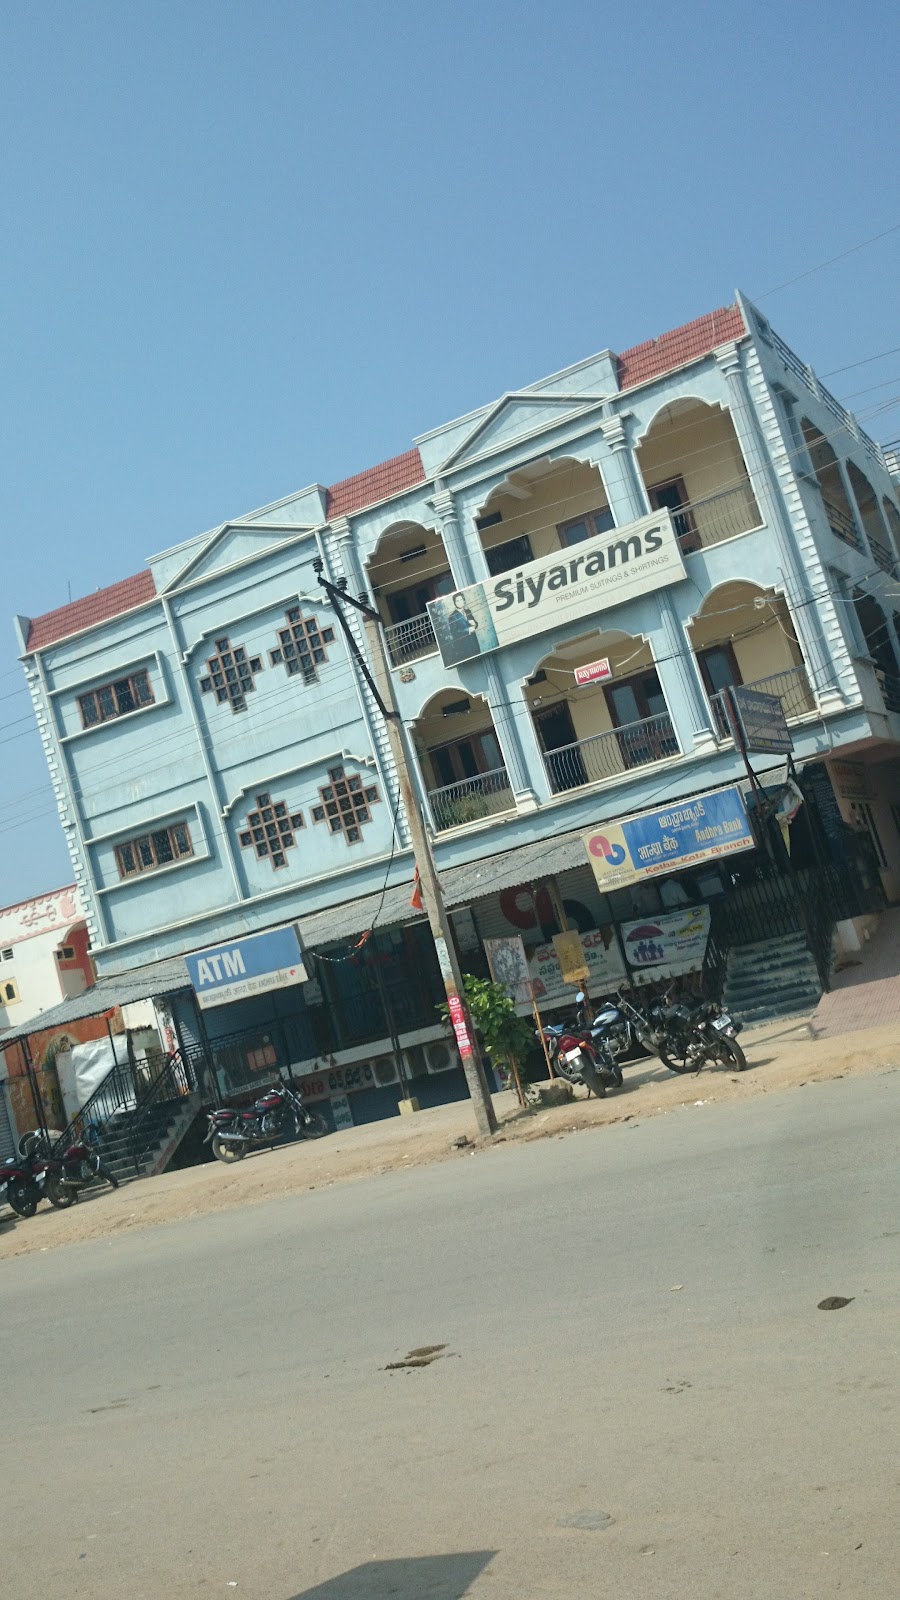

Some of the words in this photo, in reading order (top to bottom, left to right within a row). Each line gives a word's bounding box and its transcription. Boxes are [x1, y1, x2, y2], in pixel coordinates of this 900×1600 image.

[494, 526, 663, 612] Siyarams
[556, 586, 589, 603] PREMIUM
[590, 573, 622, 592] SUITINGS
[623, 568, 629, 578] &
[630, 555, 669, 577] SHIRTINGS
[577, 661, 609, 682] Raymond
[695, 826, 723, 843] Andhra
[723, 818, 743, 834] Bank
[645, 860, 677, 875] Kotha
[681, 852, 706, 864] Kota
[711, 838, 751, 854] Branch
[197, 949, 246, 986] ATM
